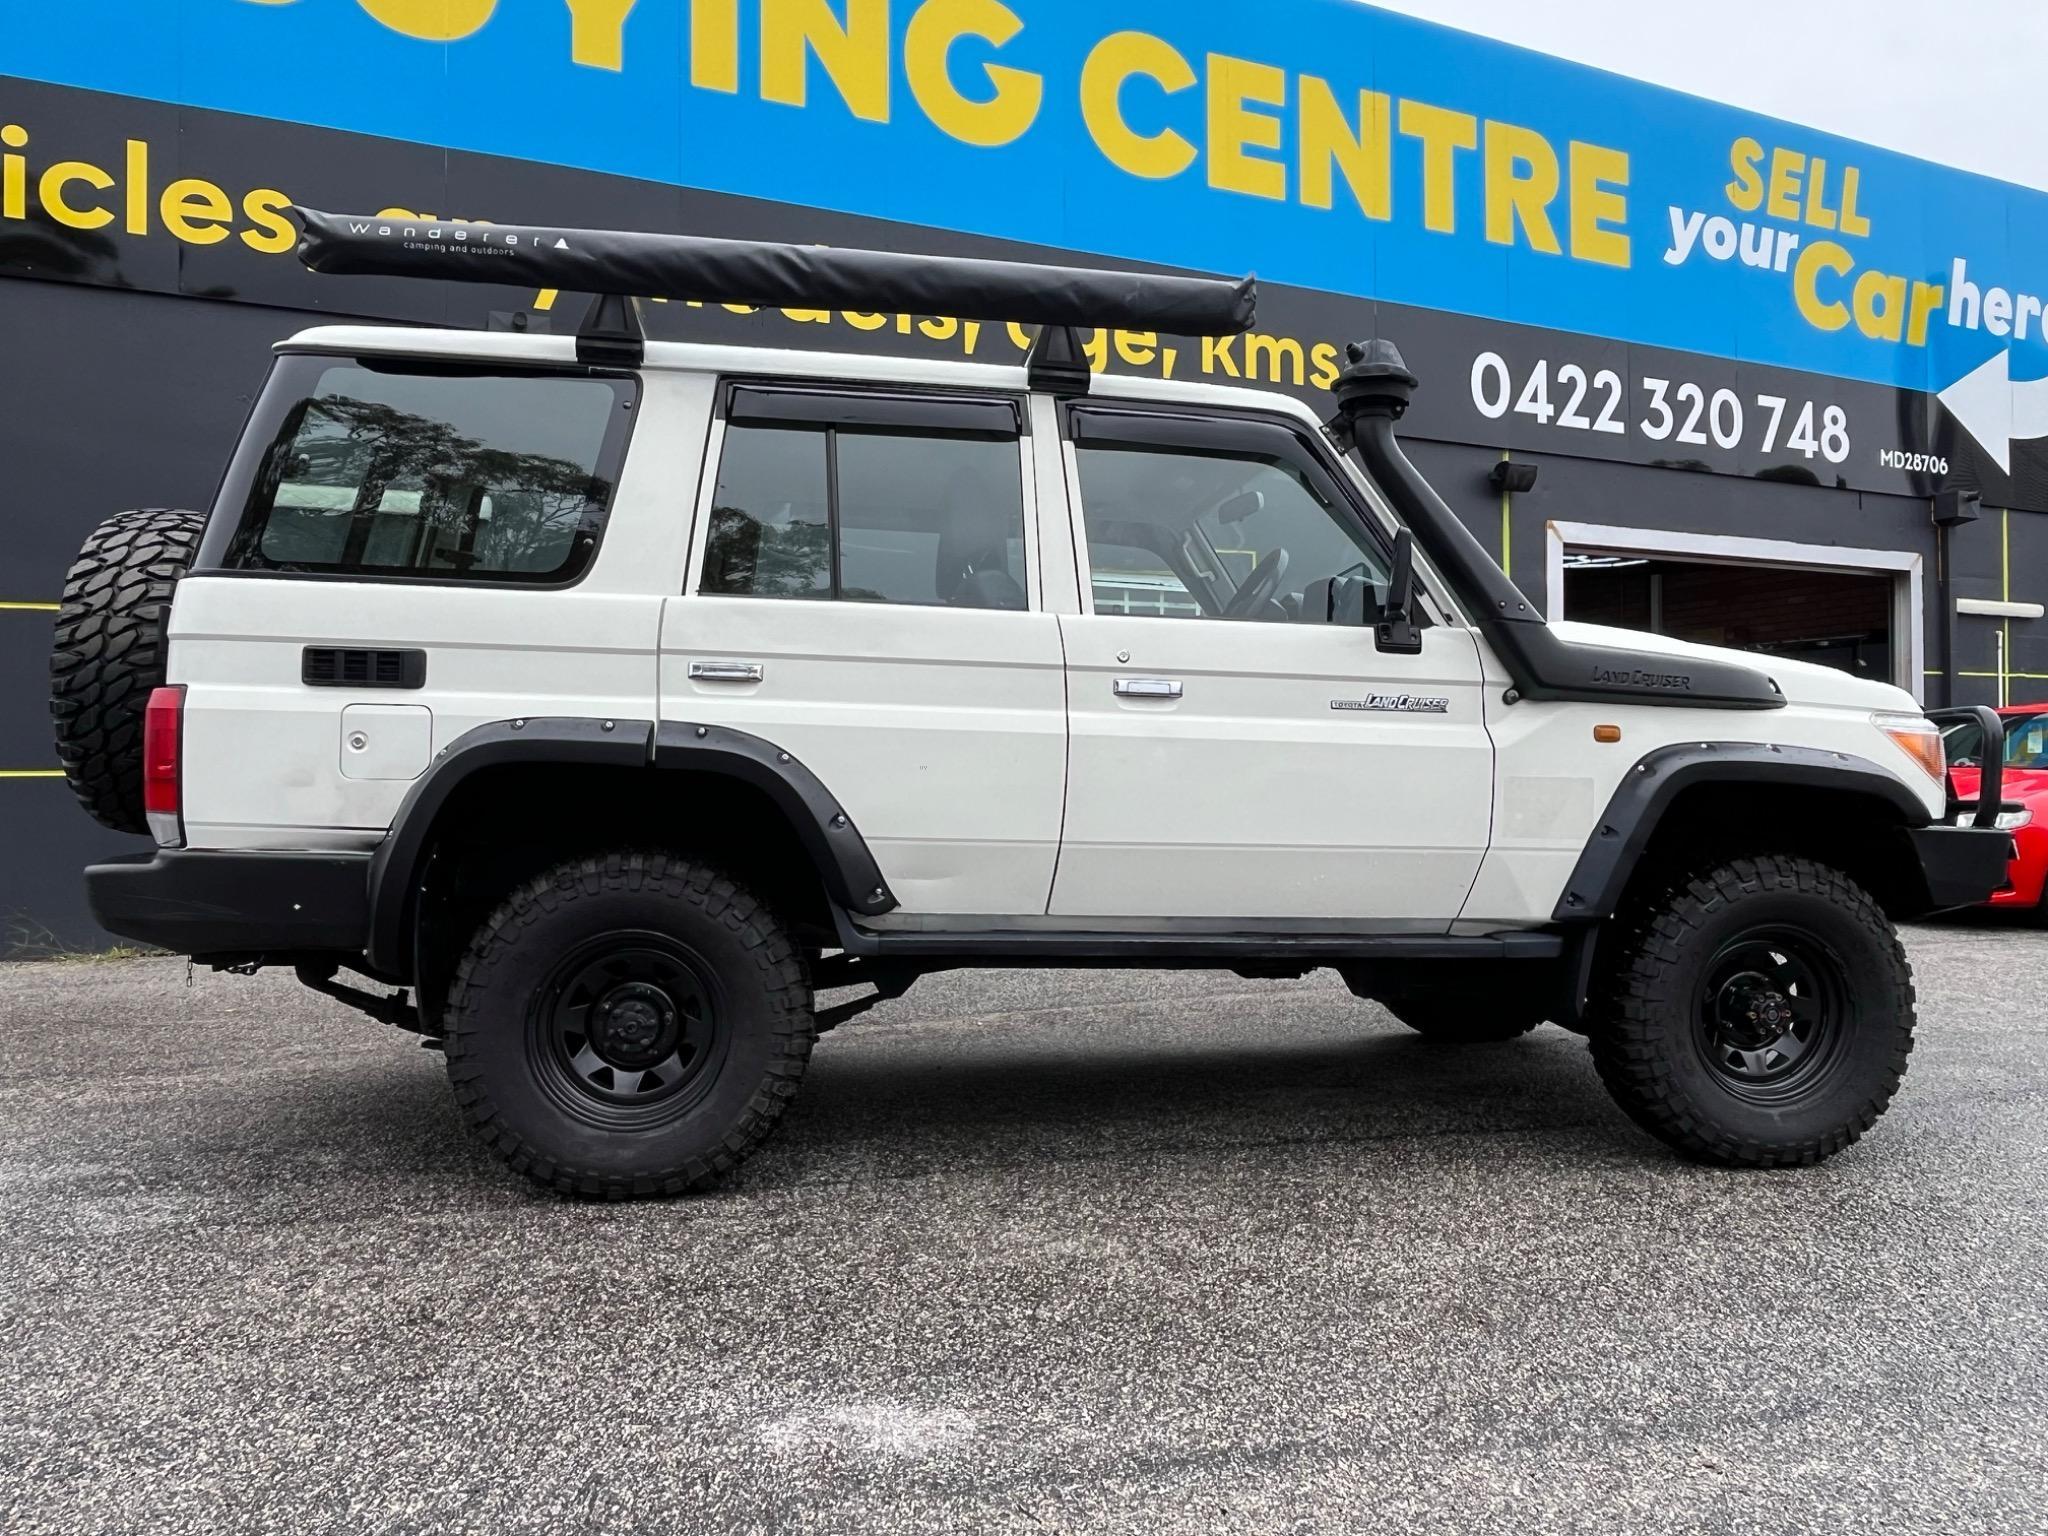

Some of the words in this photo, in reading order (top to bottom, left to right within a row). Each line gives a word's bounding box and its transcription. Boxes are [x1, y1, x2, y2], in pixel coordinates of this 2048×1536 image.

[1081, 31, 1630, 267] CENTRE
[1726, 137, 1871, 237] SELL
[349, 221, 540, 248] wanderer
[403, 241, 446, 254] camping
[449, 245, 467, 253] and
[471, 247, 515, 257] outdoors
[1664, 205, 1799, 273] your
[1794, 241, 1944, 346] Car
[1948, 257, 2048, 345] her
[1470, 351, 1625, 434] 0422
[1640, 376, 1744, 450] 320
[1757, 394, 1851, 464] 748
[1880, 448, 1949, 475] MD28706
